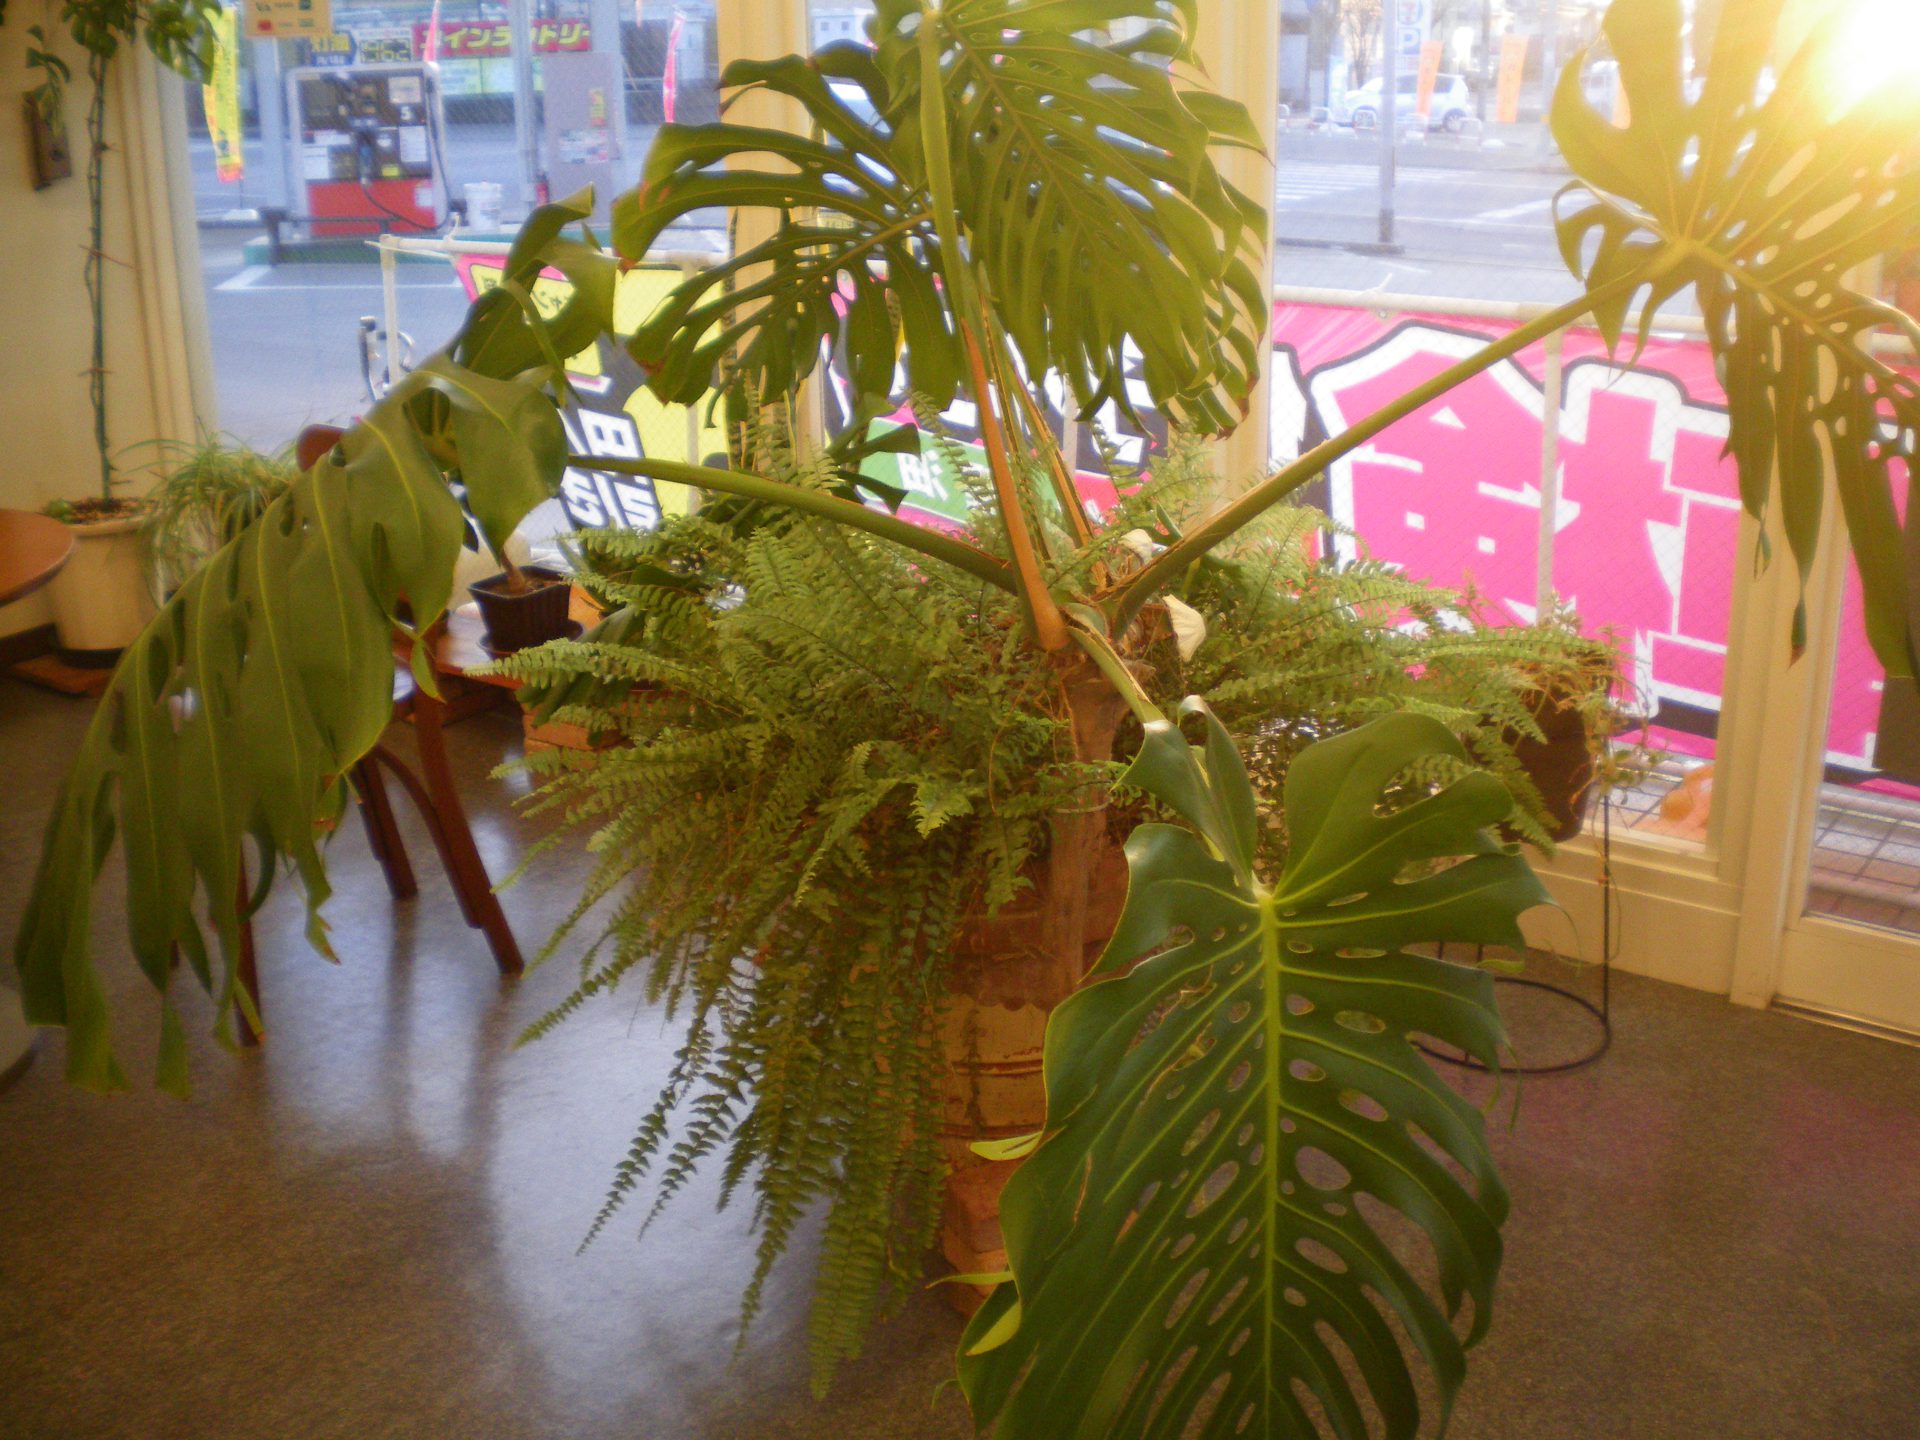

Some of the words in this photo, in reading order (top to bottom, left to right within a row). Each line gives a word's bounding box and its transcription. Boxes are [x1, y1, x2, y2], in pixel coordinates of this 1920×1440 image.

[420, 23, 591, 50] コインラドリー
